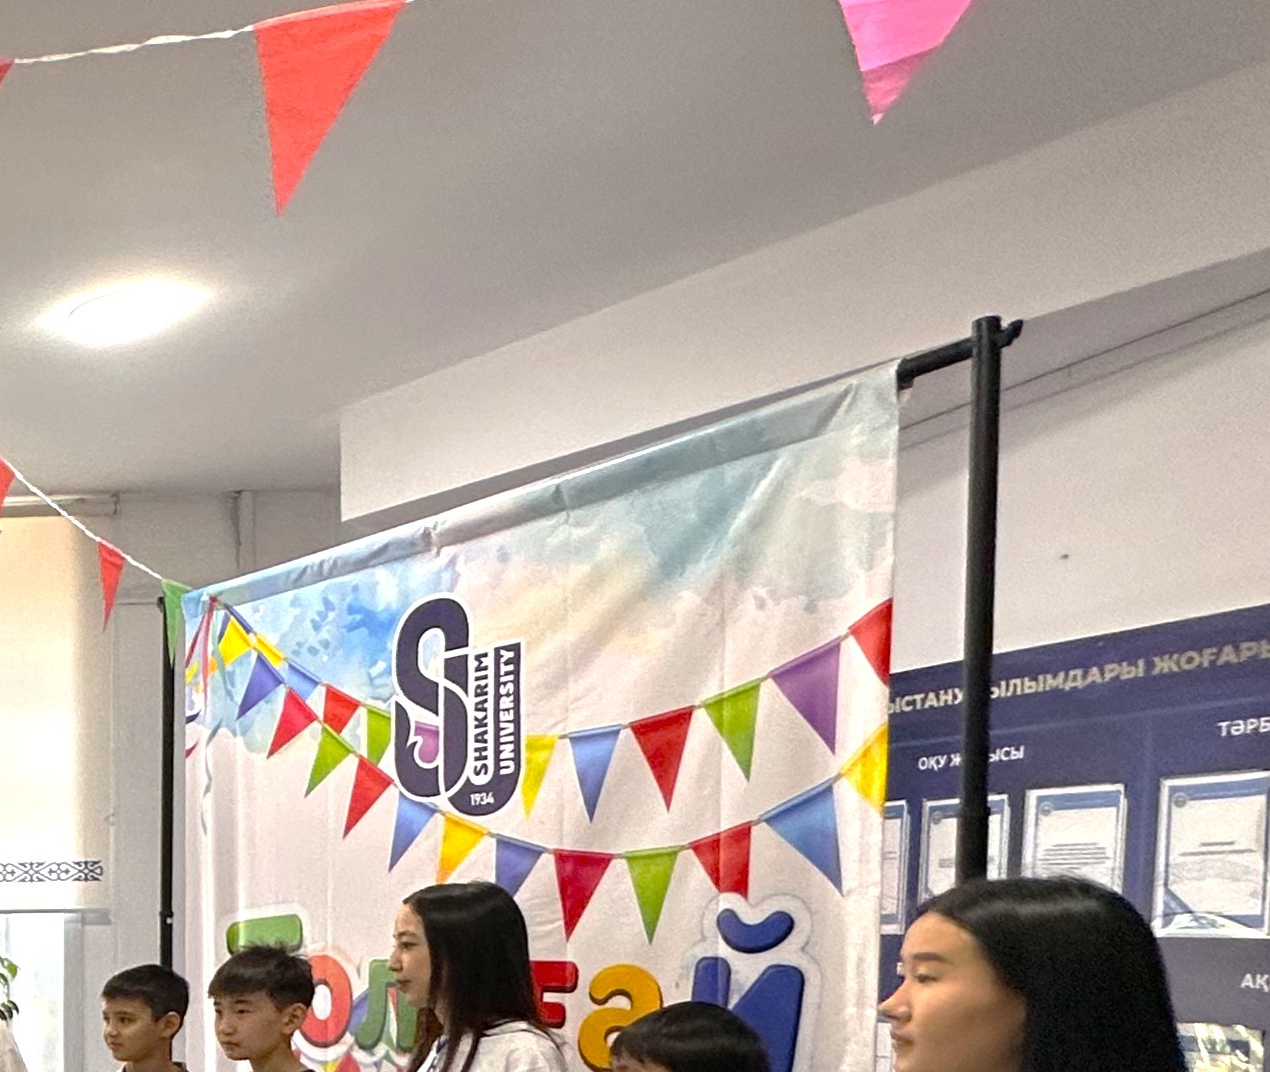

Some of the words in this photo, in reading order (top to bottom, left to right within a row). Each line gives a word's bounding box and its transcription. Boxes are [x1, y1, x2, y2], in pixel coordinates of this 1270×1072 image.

[473, 651, 489, 778] SHAKARIM
[499, 649, 516, 776] UNIVERSITY
[989, 658, 1145, 699] ЫЛЫМДАРЫ
[470, 792, 495, 806] 1934
